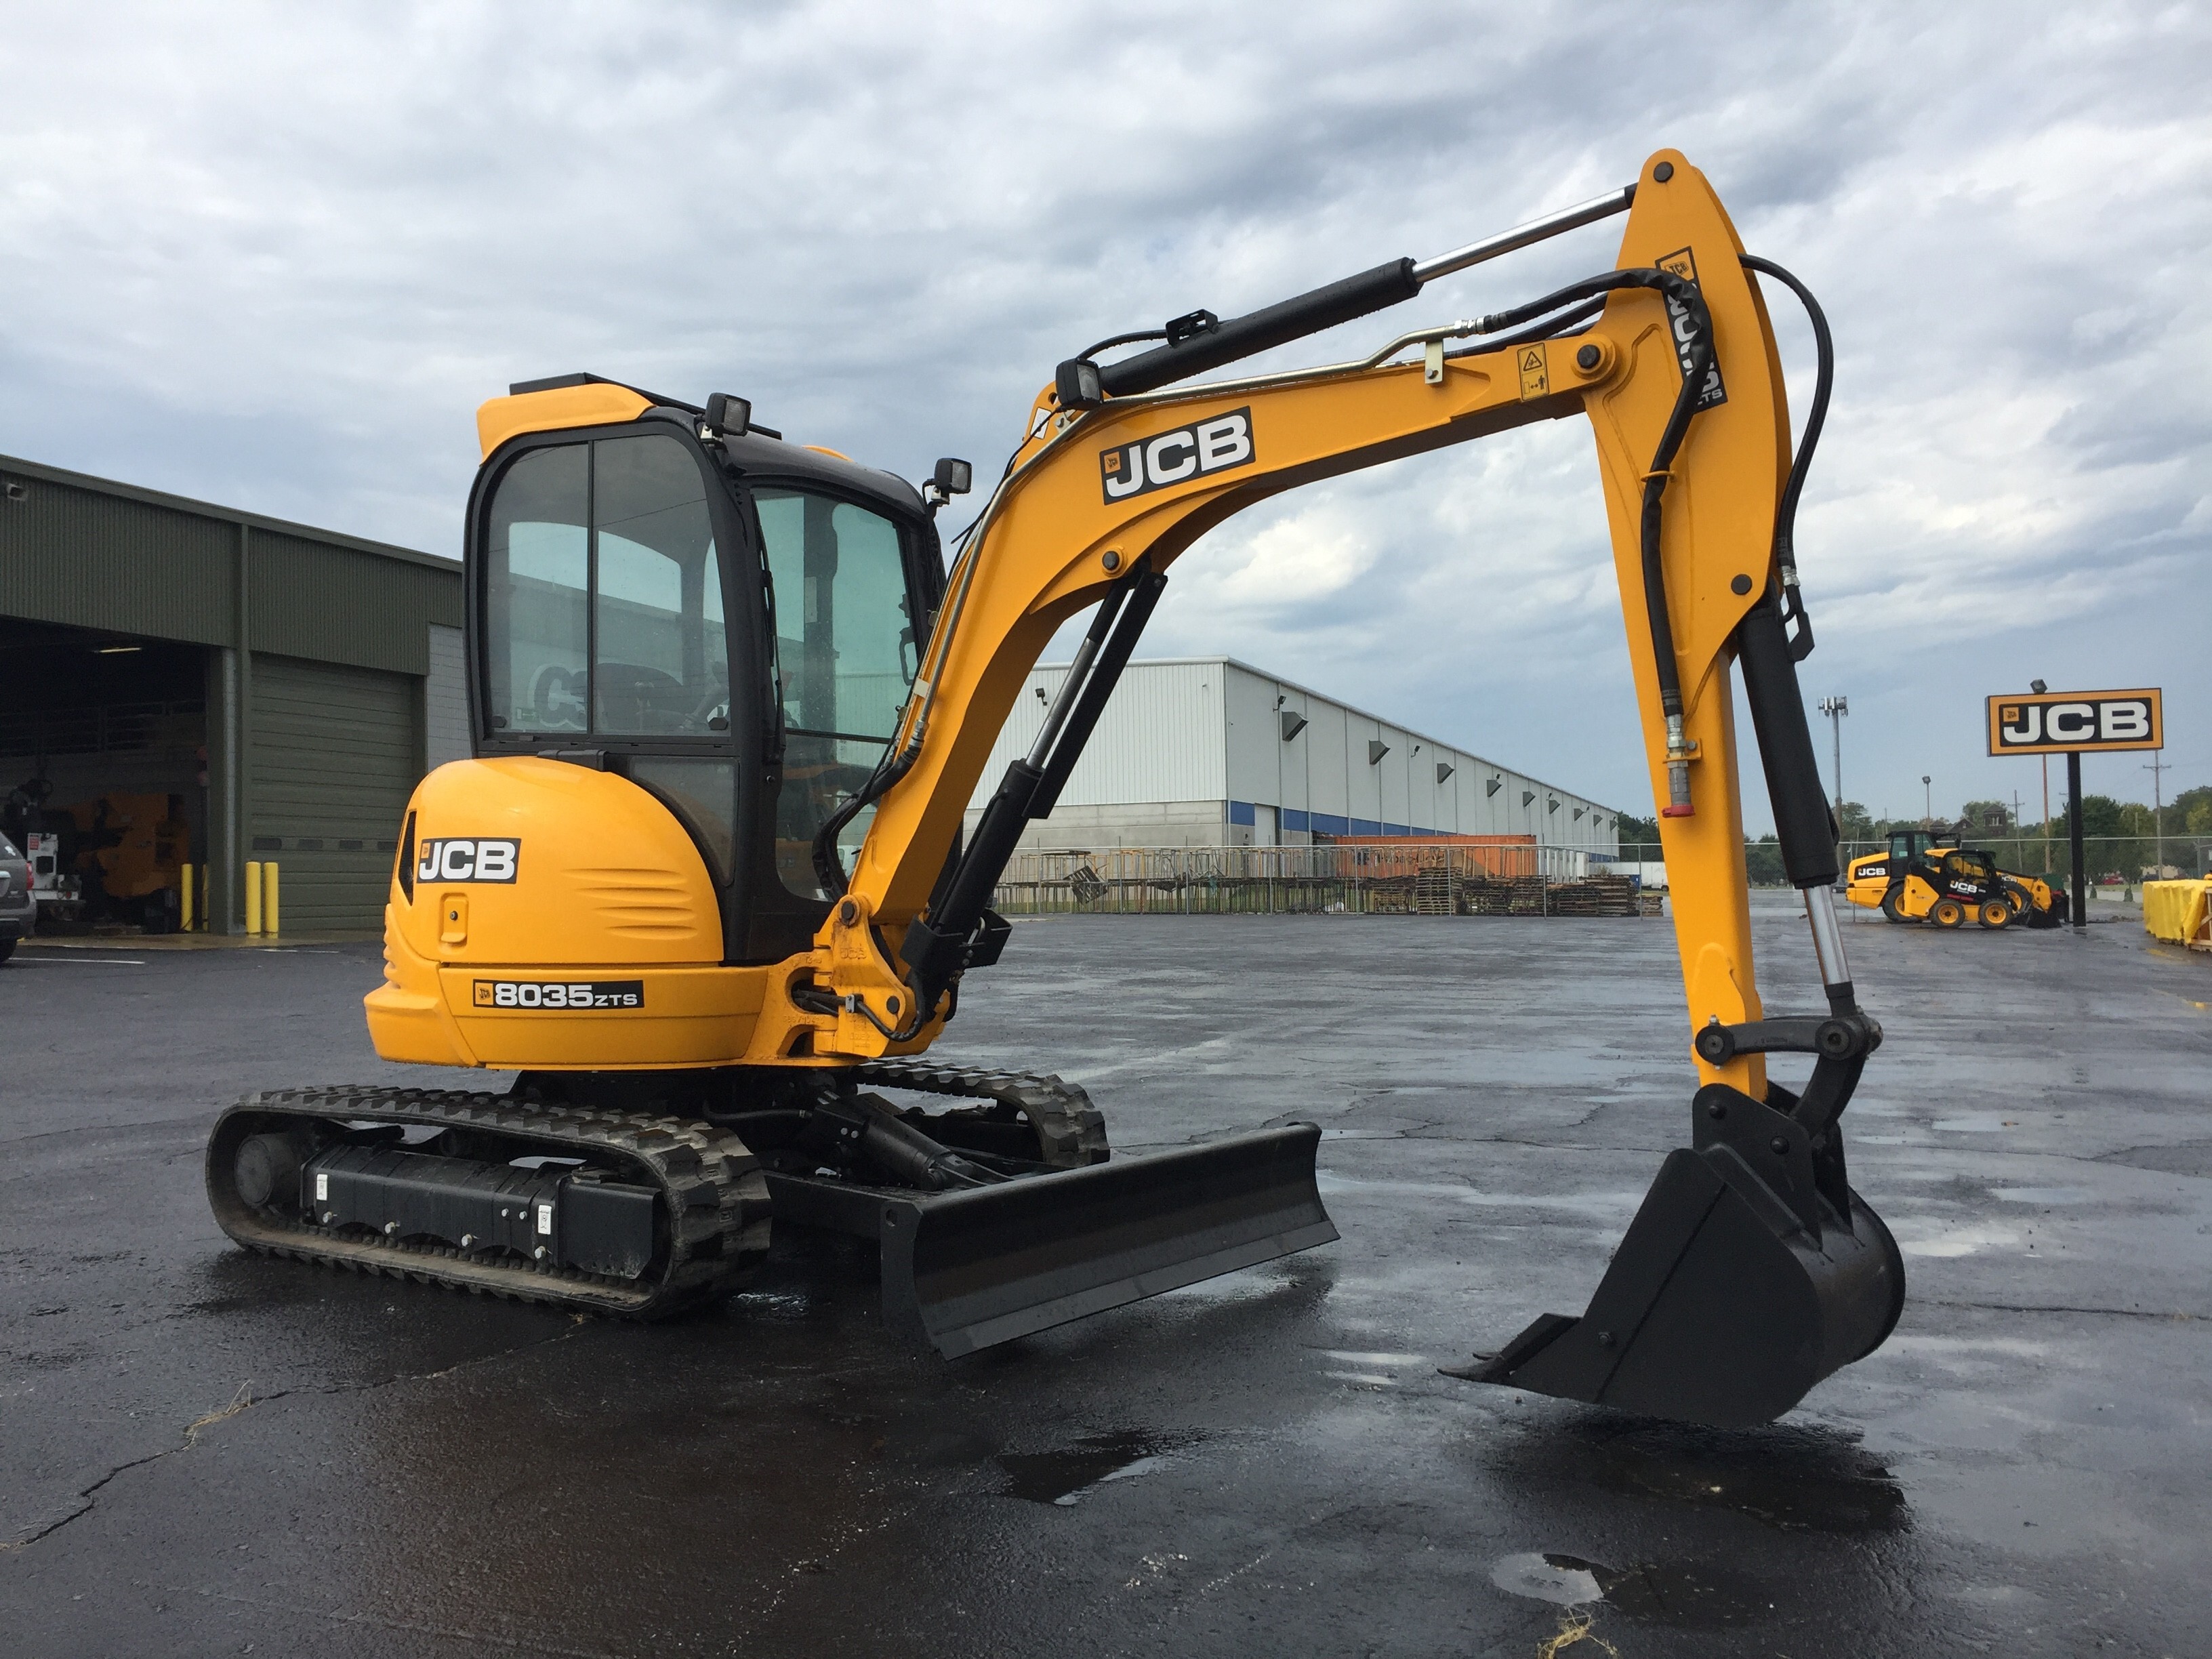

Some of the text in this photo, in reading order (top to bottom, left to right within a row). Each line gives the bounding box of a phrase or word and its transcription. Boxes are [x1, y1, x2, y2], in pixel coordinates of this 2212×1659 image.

[1106, 415, 1250, 497] JCB
[2003, 701, 2149, 743] JCB
[419, 840, 516, 880] JCB
[1950, 881, 1978, 893] JCB
